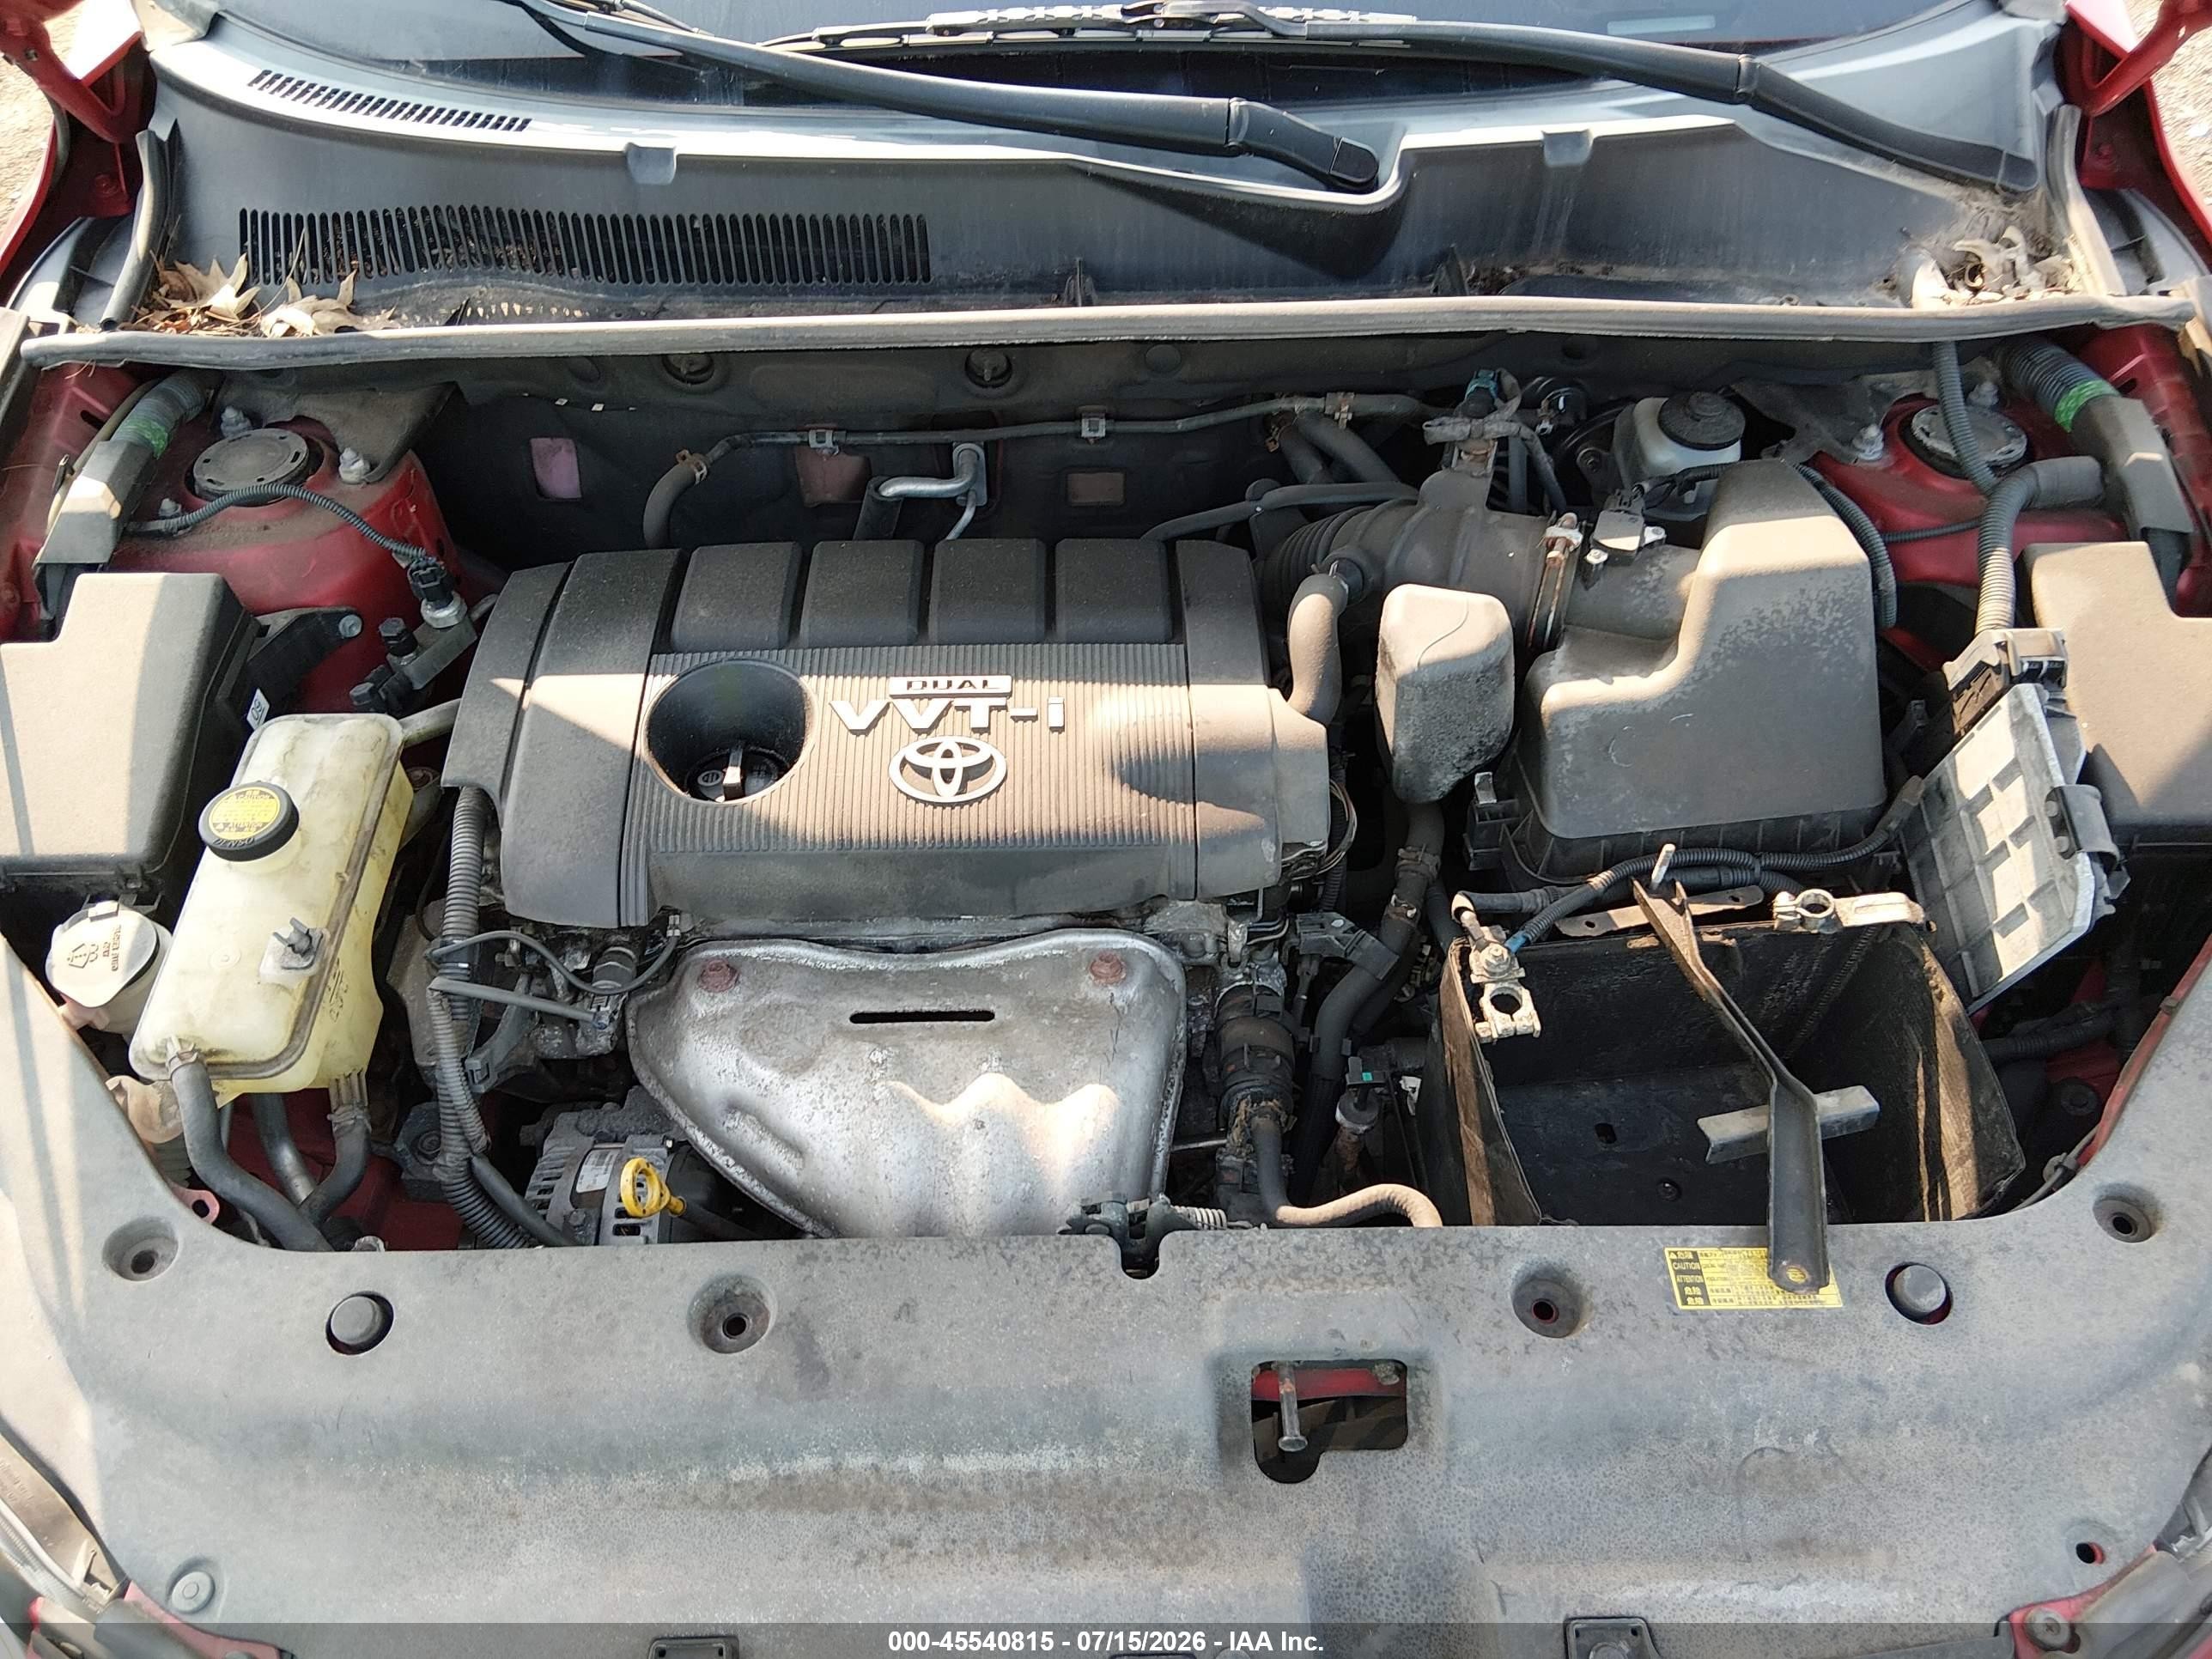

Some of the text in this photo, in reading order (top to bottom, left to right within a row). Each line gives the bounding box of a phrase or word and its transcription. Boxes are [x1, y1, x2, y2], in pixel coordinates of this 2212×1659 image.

[907, 679, 1001, 690] DUAL
[830, 696, 1065, 735] VVT-i
[1672, 1261, 1700, 1270] CAUTION
